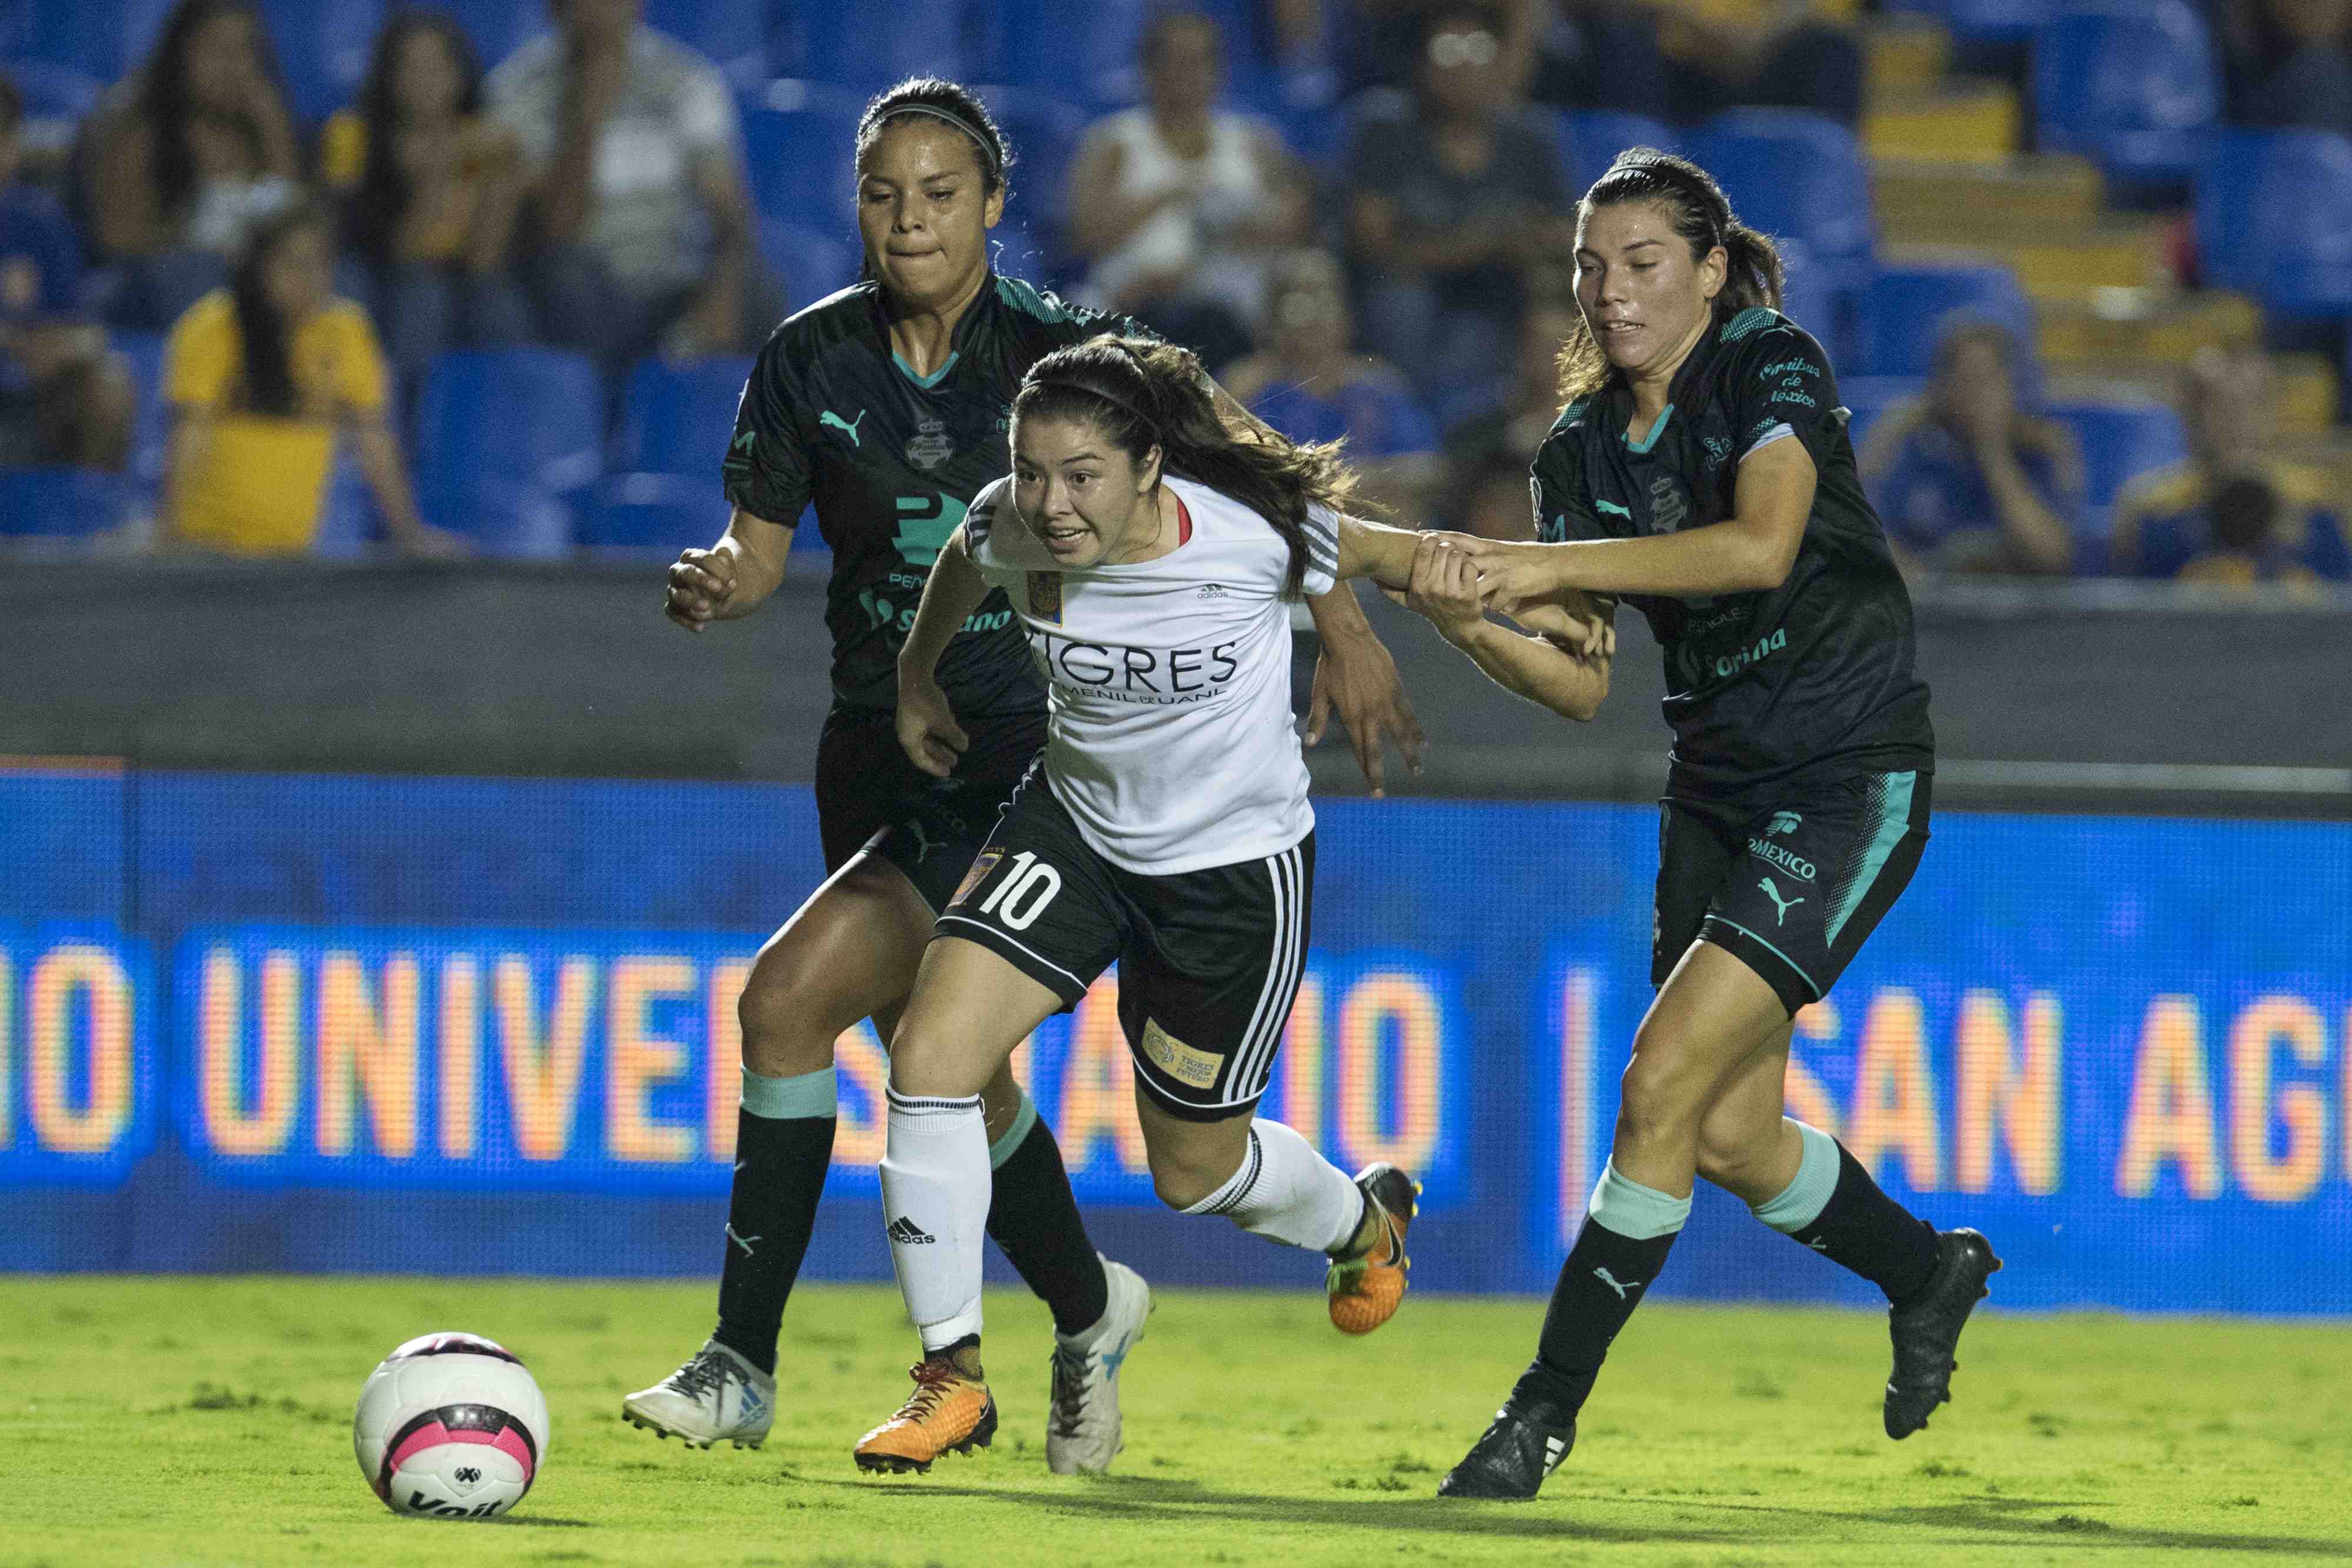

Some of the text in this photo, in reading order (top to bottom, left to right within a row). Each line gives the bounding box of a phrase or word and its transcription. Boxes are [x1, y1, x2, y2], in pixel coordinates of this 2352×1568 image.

[1781, 372, 1802, 386] de
[980, 851, 1061, 930] 10
[2114, 991, 2352, 1205] AG
